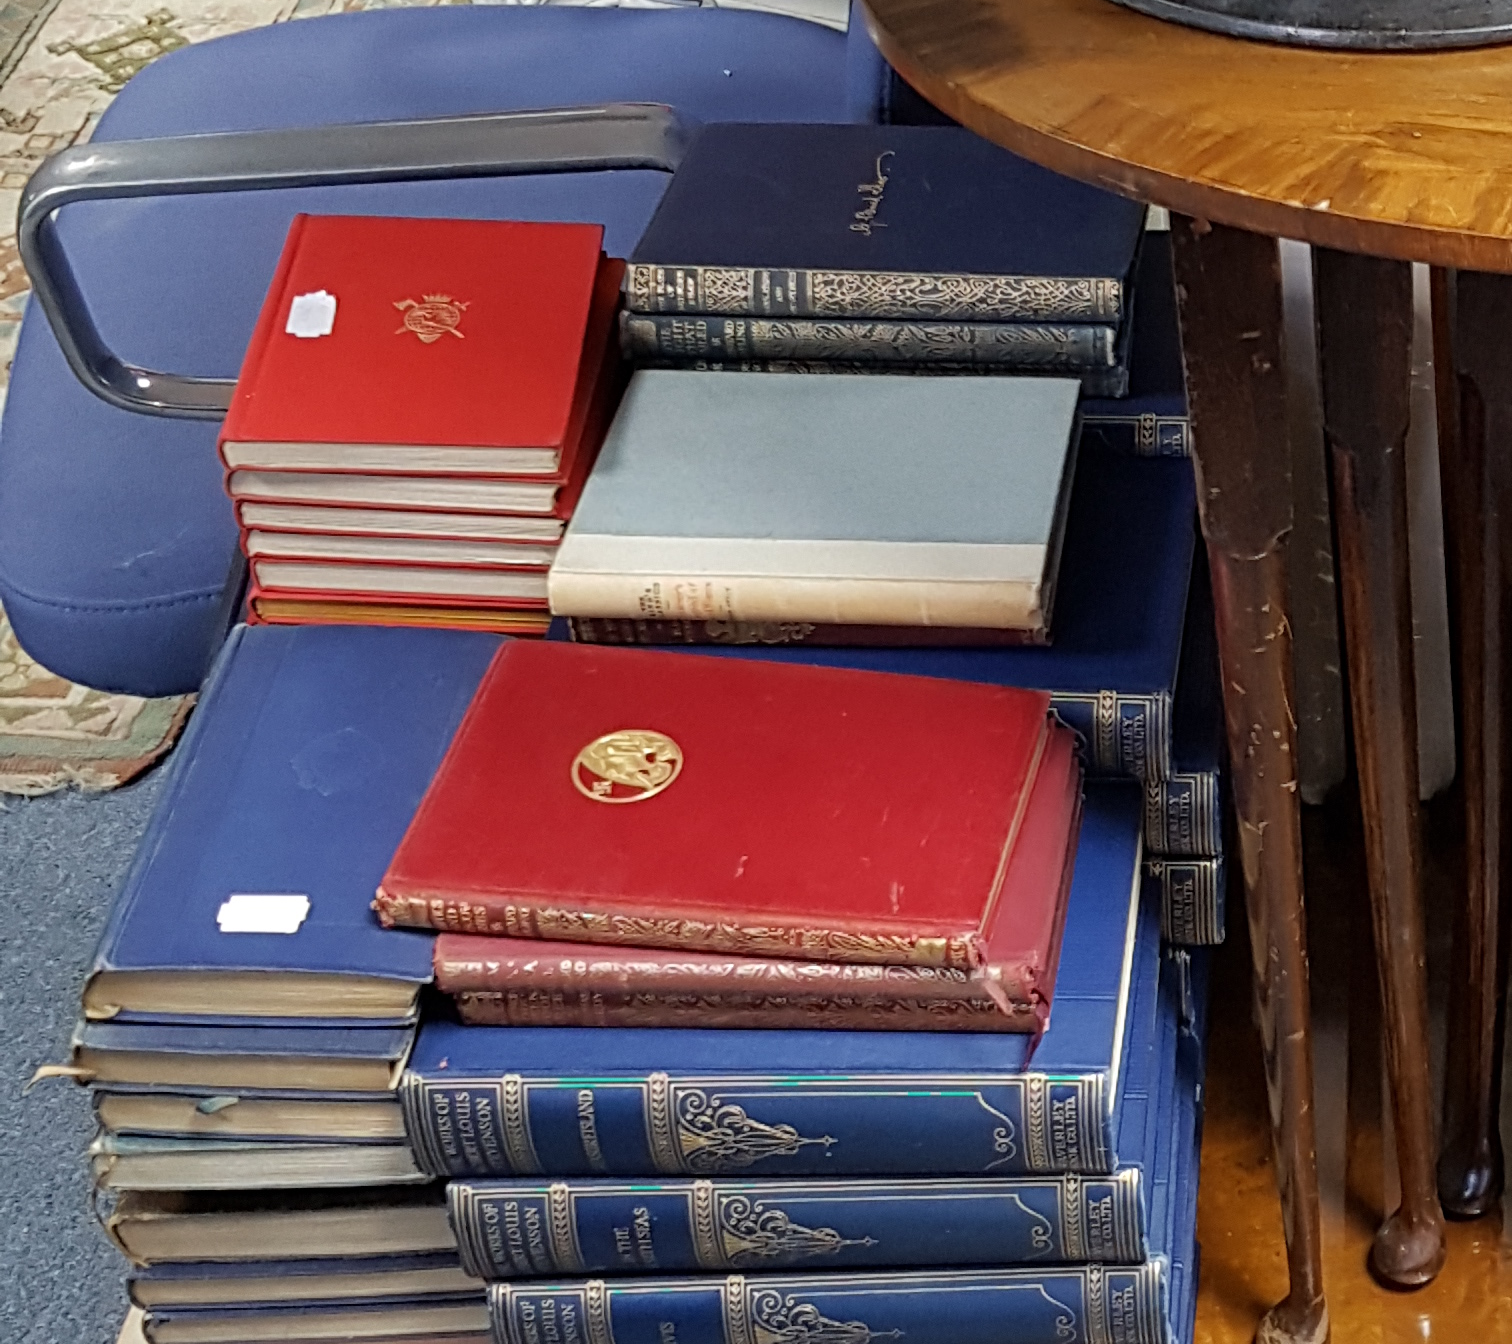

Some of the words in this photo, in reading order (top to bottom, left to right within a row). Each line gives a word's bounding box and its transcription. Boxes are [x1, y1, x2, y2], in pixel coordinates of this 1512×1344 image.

[433, 1093, 450, 1115] OF
[454, 1091, 475, 1139] LOUIS
[482, 1203, 499, 1224] OF
[504, 1201, 523, 1246] LOUIS
[518, 1300, 537, 1321] OF
[540, 1298, 561, 1342] LOUIS
